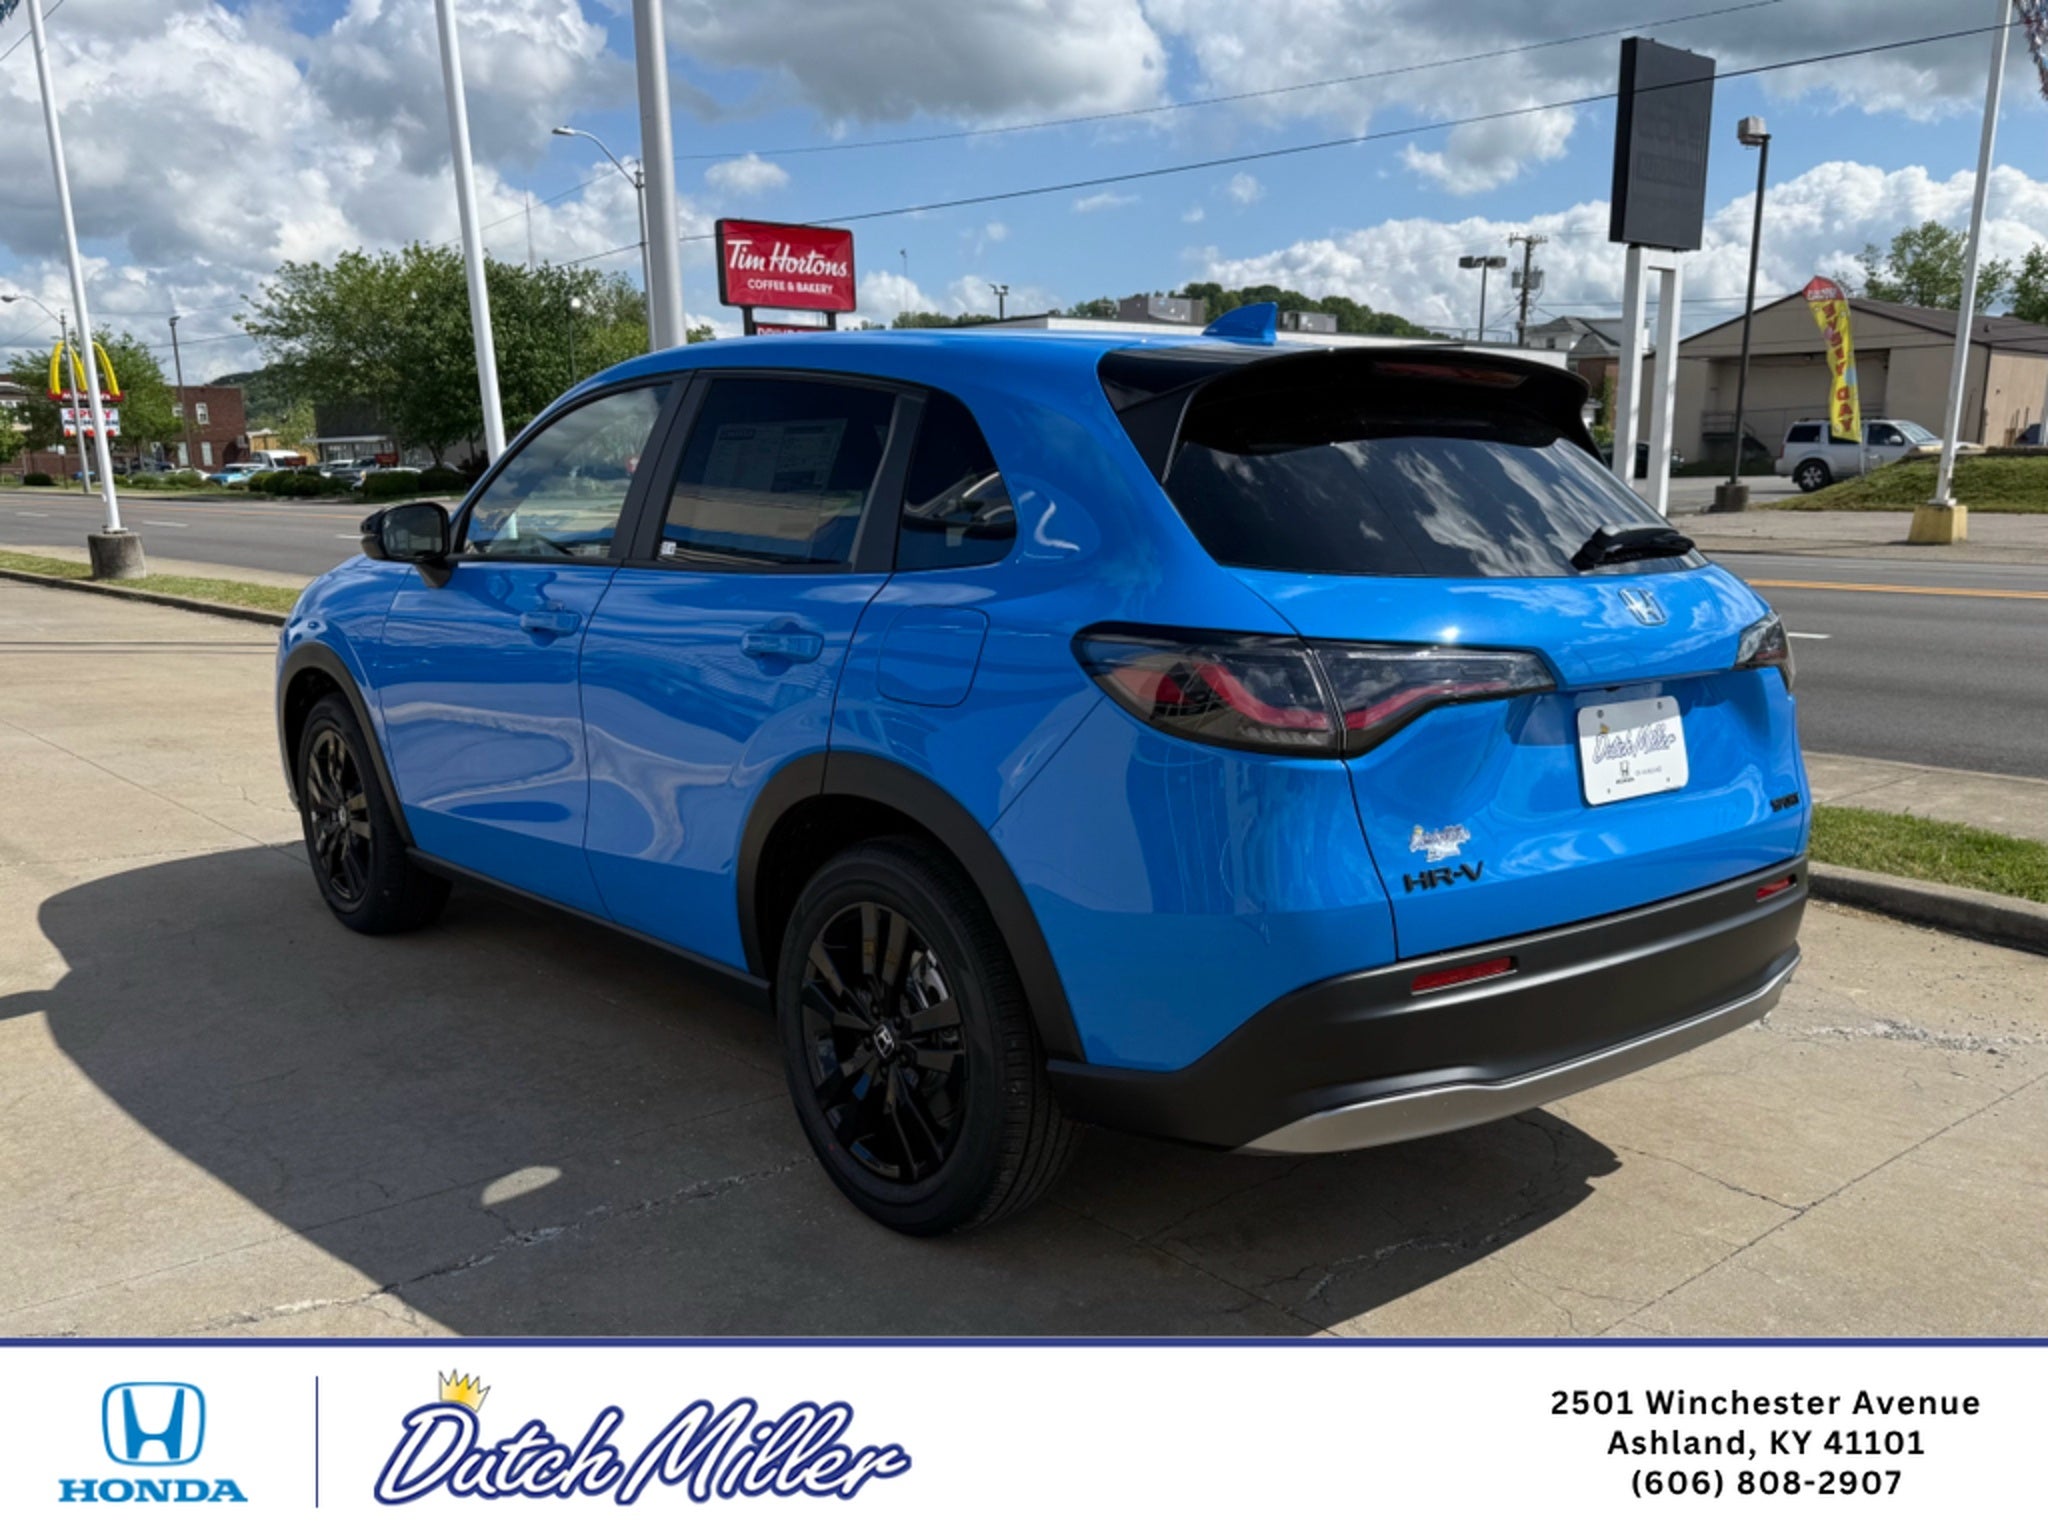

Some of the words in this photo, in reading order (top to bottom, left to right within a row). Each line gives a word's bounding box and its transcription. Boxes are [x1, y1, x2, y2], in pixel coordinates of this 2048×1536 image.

[726, 239, 766, 272] Tim
[769, 241, 848, 278] Hortons
[747, 278, 786, 292] COFFEE
[787, 280, 795, 292] &
[796, 281, 834, 295] BAKERY
[1403, 860, 1484, 893] HR-V
